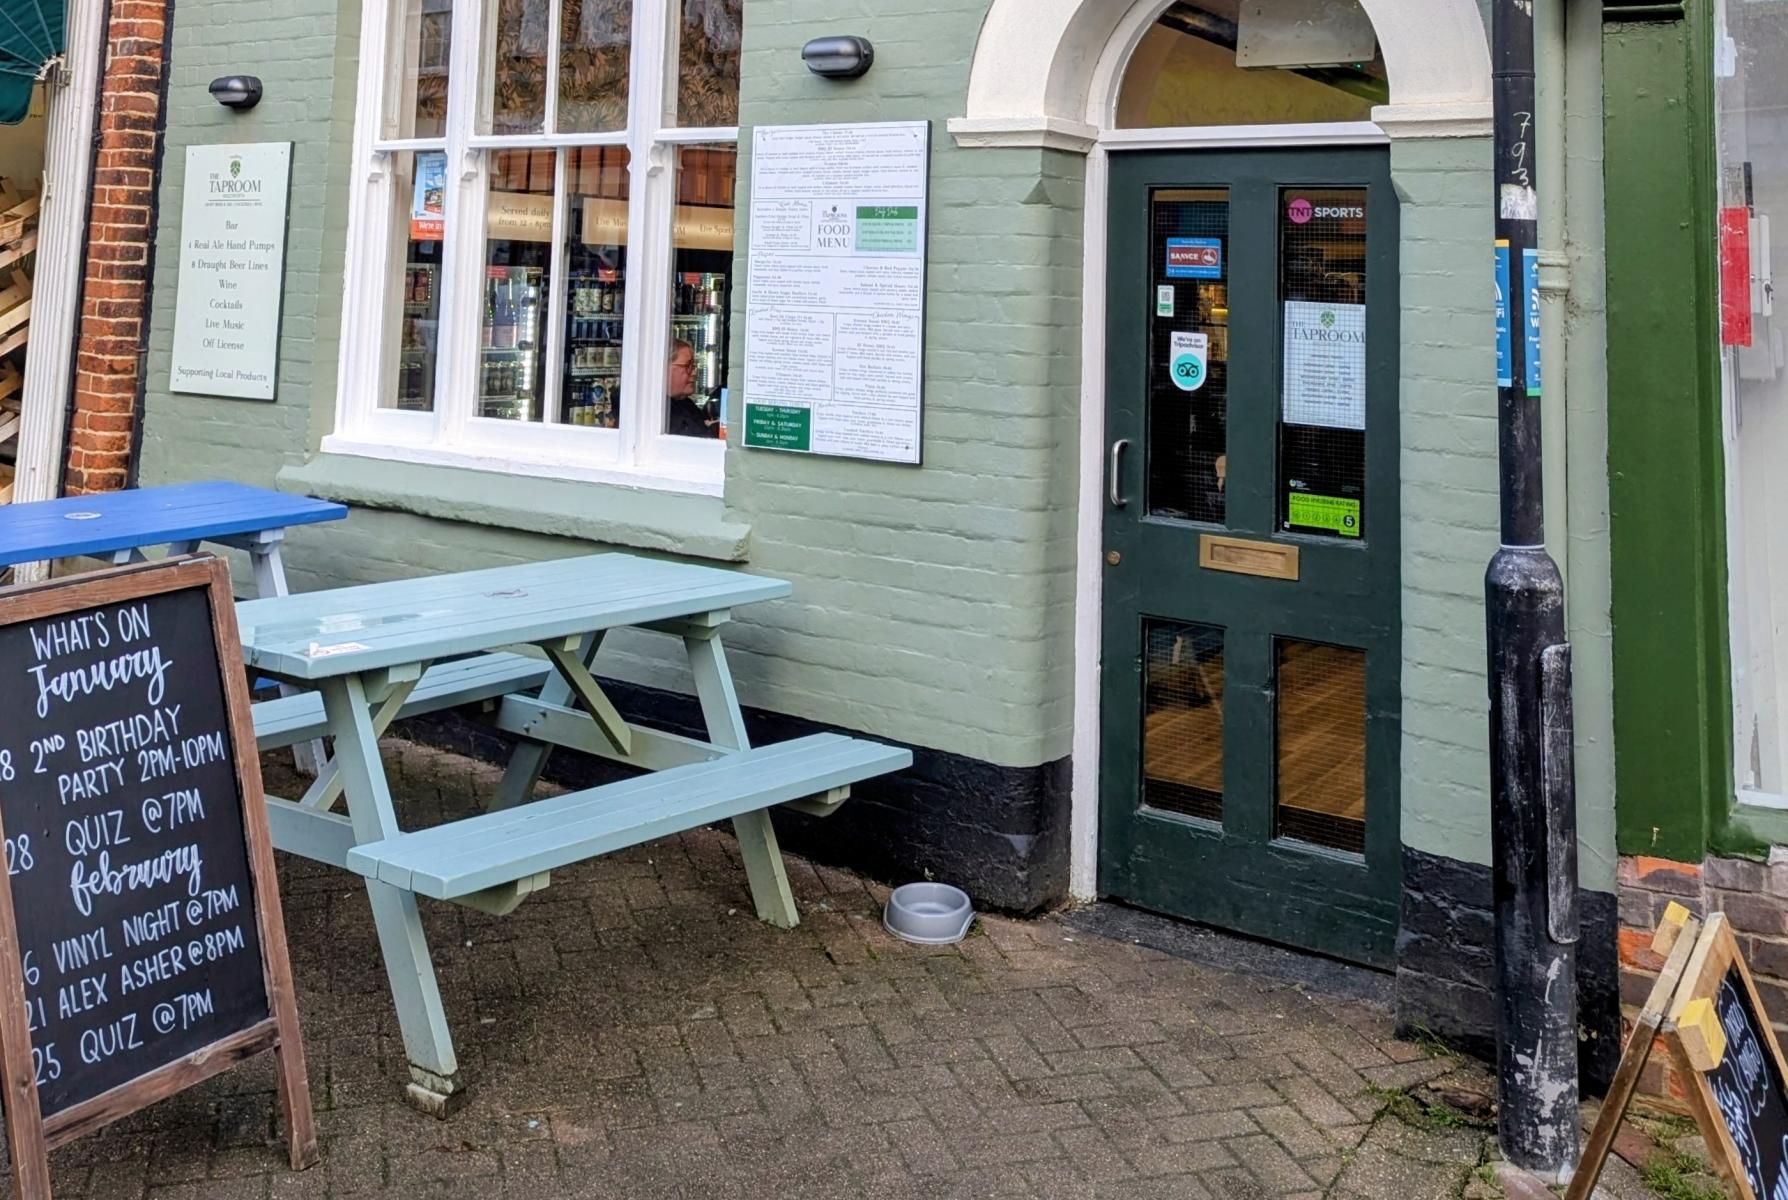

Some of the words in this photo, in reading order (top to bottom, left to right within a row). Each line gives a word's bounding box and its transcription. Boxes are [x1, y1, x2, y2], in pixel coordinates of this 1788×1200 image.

[208, 179, 262, 193] TAPROOM
[1314, 207, 1363, 218] SPORTS
[225, 220, 239, 230] Bar
[818, 224, 850, 235] FOOD
[194, 240, 209, 250] Real
[212, 240, 224, 250] Ale
[226, 239, 247, 250] Hand
[248, 240, 275, 253] Pumps
[817, 237, 849, 248] MENU
[198, 259, 227, 272] Draught
[229, 259, 246, 271] Beer
[248, 259, 269, 271] Lines
[218, 279, 238, 290] Wine
[209, 298, 243, 311] Cocktails
[205, 318, 220, 330] Live
[222, 319, 245, 331] Music
[1292, 328, 1365, 343] TAPROOM
[202, 338, 214, 349] Off
[216, 338, 245, 351] License
[177, 365, 214, 380] Supporting
[215, 367, 234, 381] Local
[236, 368, 268, 383] Products
[29, 611, 110, 661] WHAT'S
[118, 603, 150, 643] ON
[27, 645, 174, 718] January
[30, 733, 65, 774] 2ND
[76, 704, 181, 763] BIRTHDAY
[58, 758, 124, 805] PARTY
[137, 731, 226, 783] 2PM-10PM
[65, 809, 131, 857] QUIZ
[52, 926, 113, 974] VINYL
[122, 900, 181, 948] NIGHT
[58, 973, 109, 1020] ALEX
[120, 944, 187, 996] ASHER
[79, 1013, 144, 1064] QUIZ
